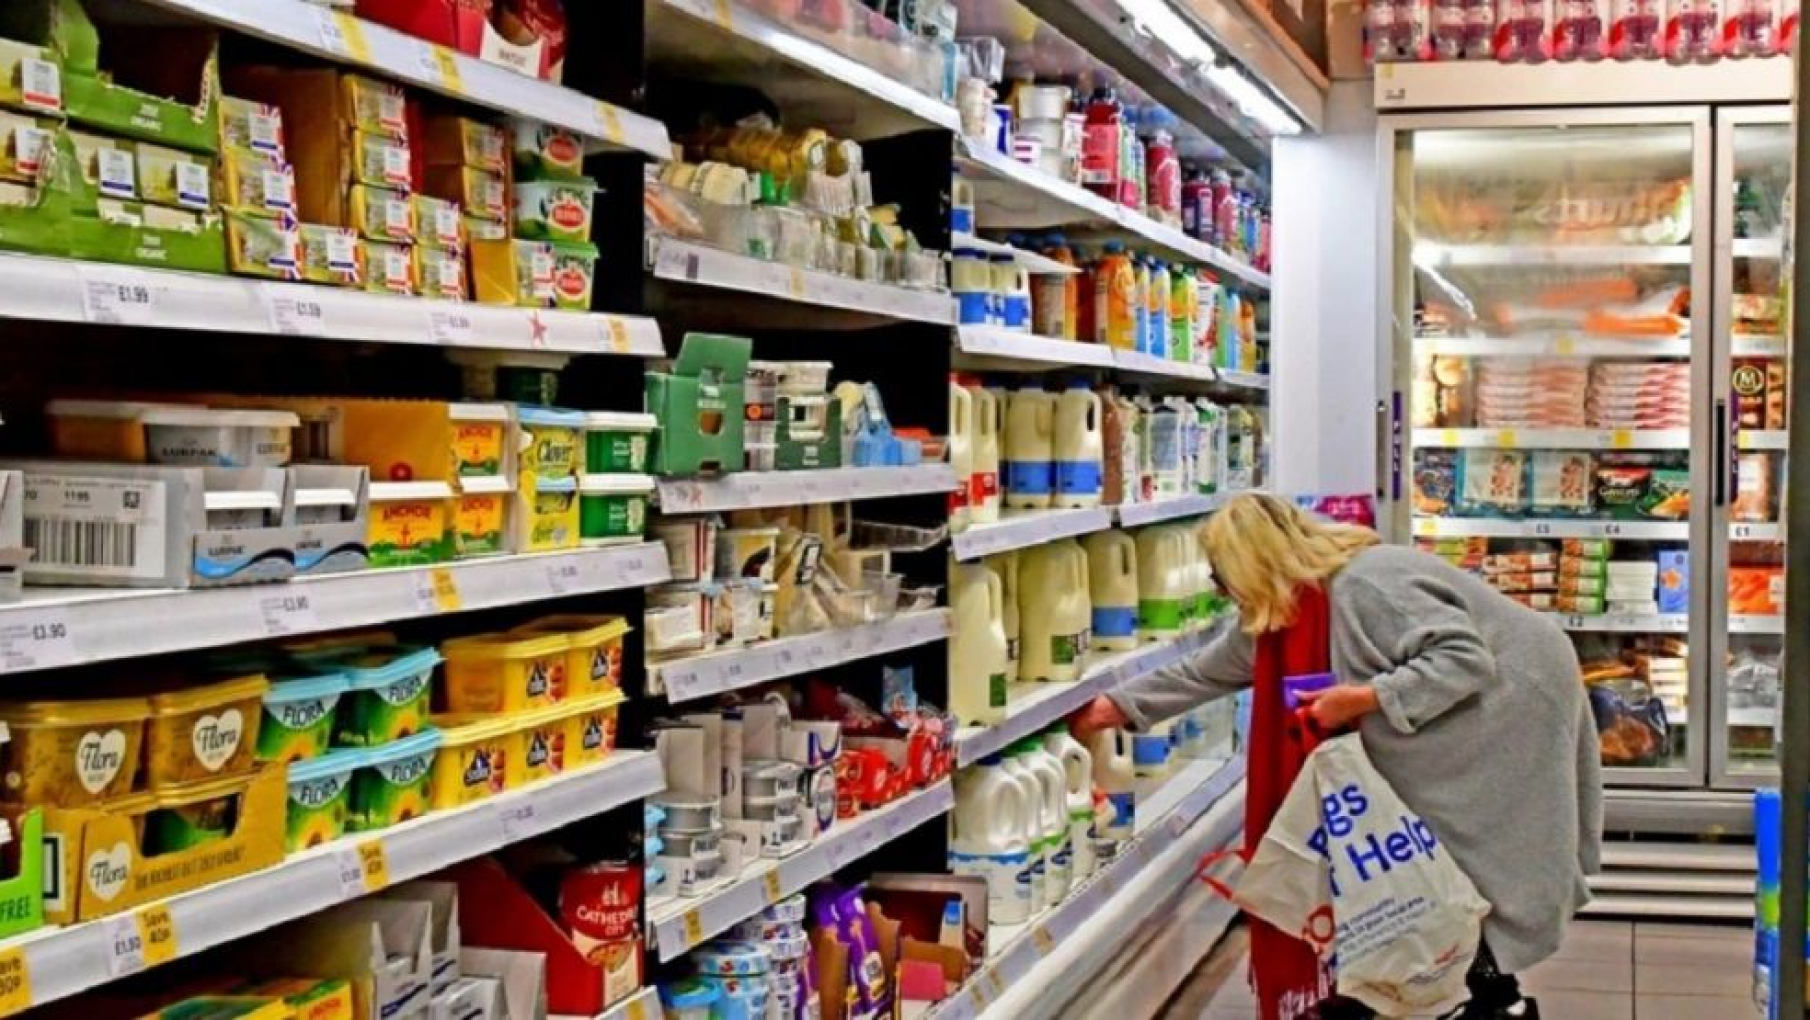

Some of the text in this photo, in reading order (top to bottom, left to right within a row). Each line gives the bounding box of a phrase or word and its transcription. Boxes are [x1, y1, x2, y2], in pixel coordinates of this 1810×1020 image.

[383, 504, 432, 521] ANCHOR
[283, 700, 326, 728] FLORA
[196, 723, 237, 752] Flora
[80, 741, 119, 771] Flora
[300, 777, 339, 805] FLORA
[1344, 814, 1437, 883] Help
[89, 860, 128, 887] Flora
